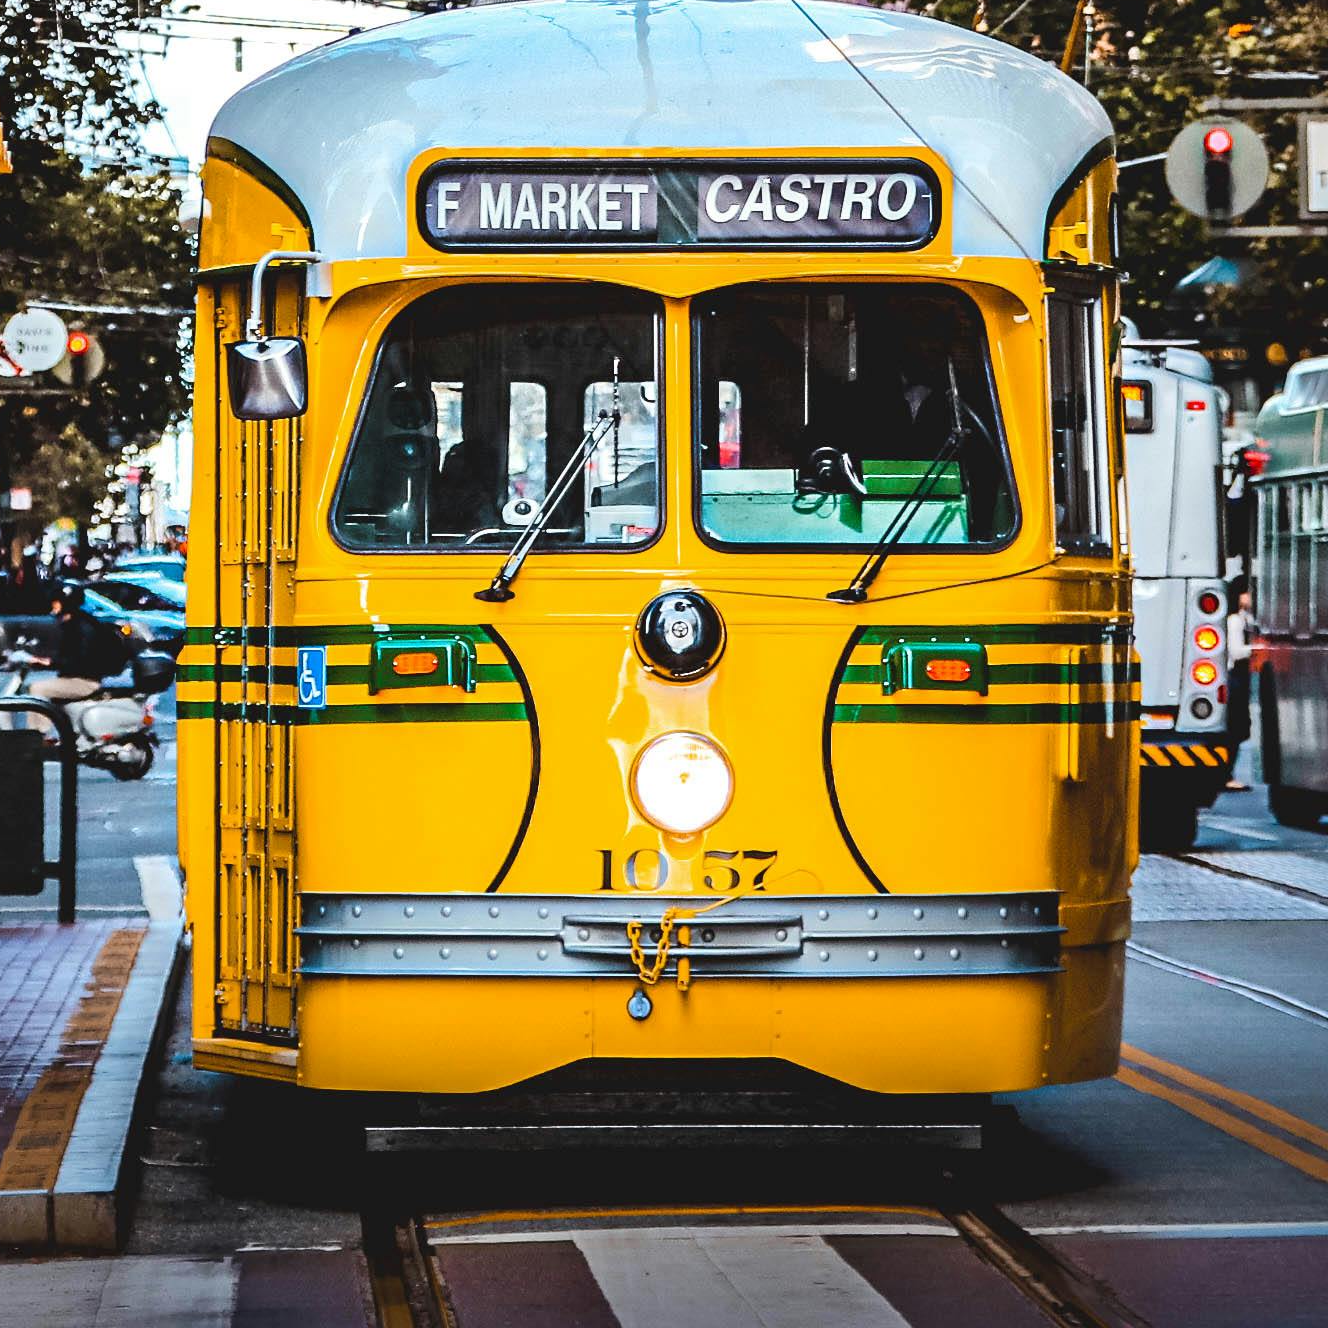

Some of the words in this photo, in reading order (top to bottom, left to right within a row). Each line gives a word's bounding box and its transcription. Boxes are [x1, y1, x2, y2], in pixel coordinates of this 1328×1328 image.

[437, 182, 461, 229] F
[478, 182, 648, 232] MARKET
[704, 173, 917, 224] CASTRO
